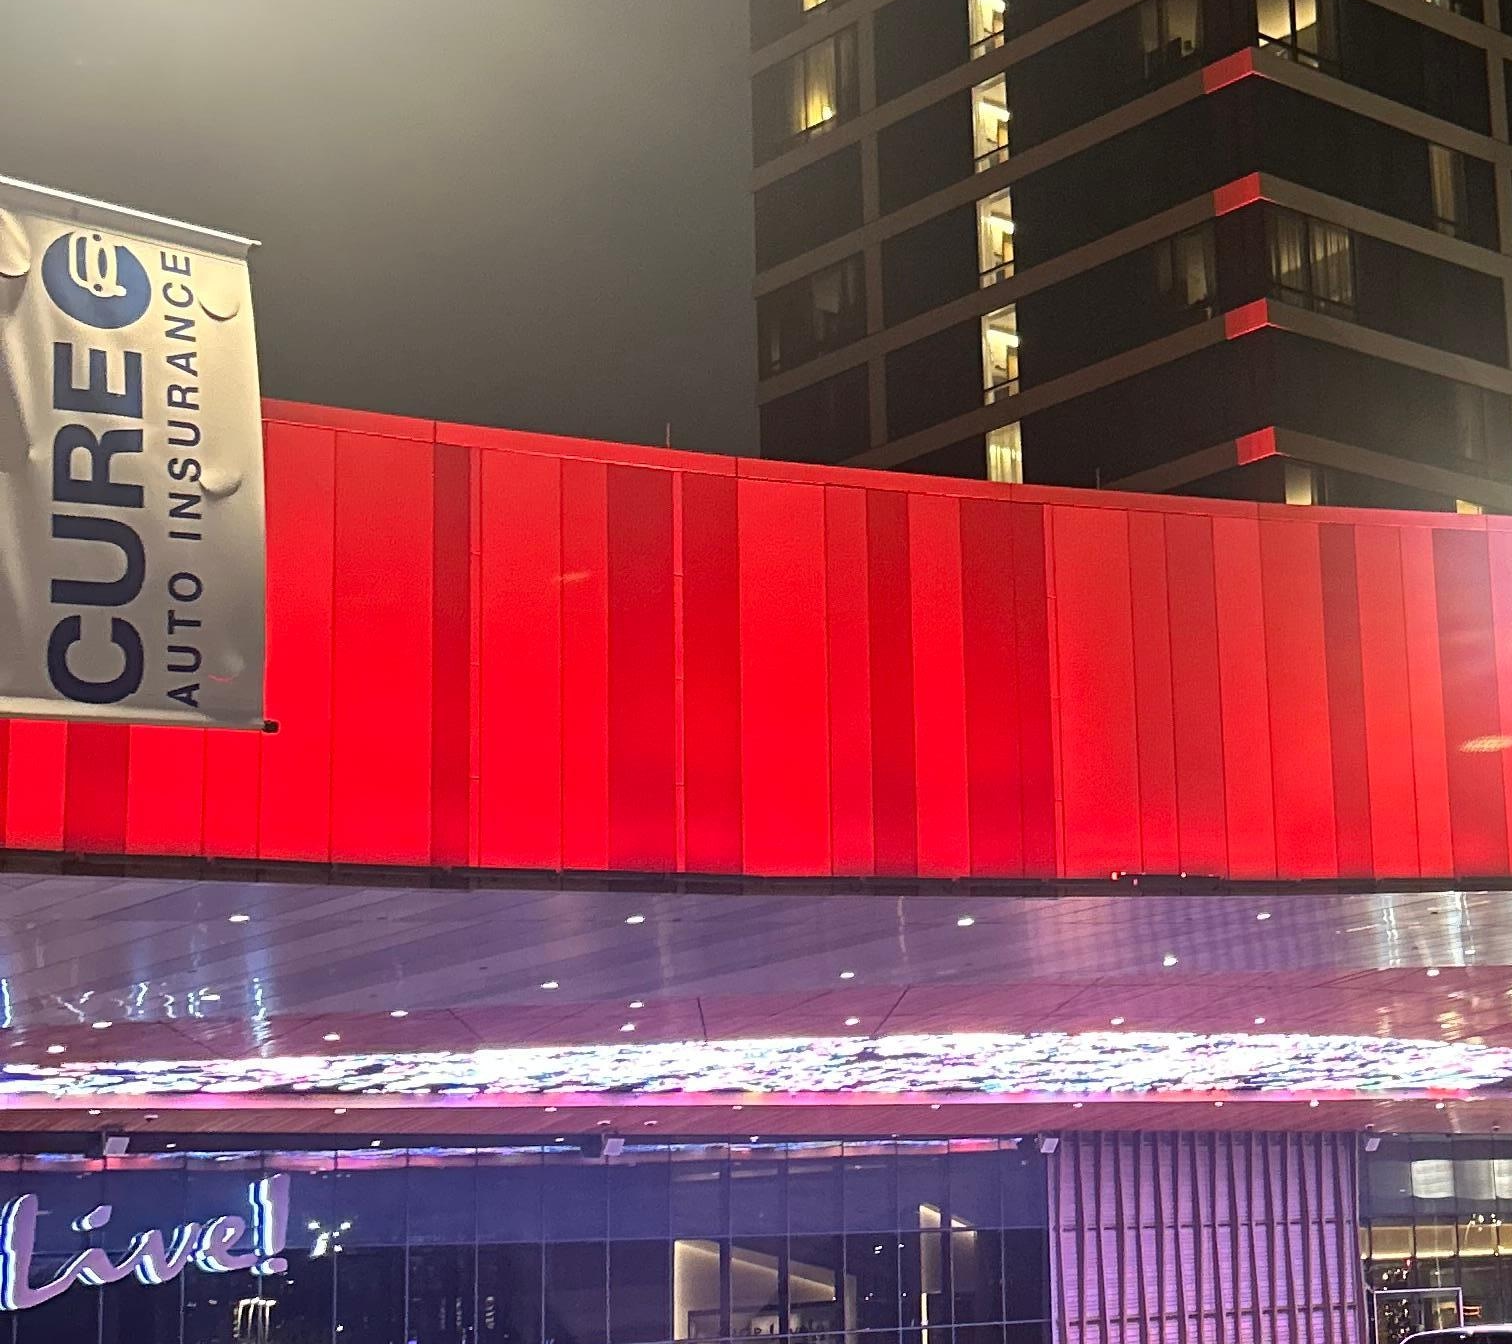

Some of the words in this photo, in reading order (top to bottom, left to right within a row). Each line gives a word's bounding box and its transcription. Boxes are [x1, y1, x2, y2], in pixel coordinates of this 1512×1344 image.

[160, 250, 202, 541] INSURANCE
[47, 341, 146, 705] CURE
[167, 571, 202, 708] AUTO
[0, 1173, 291, 1310] Live!
